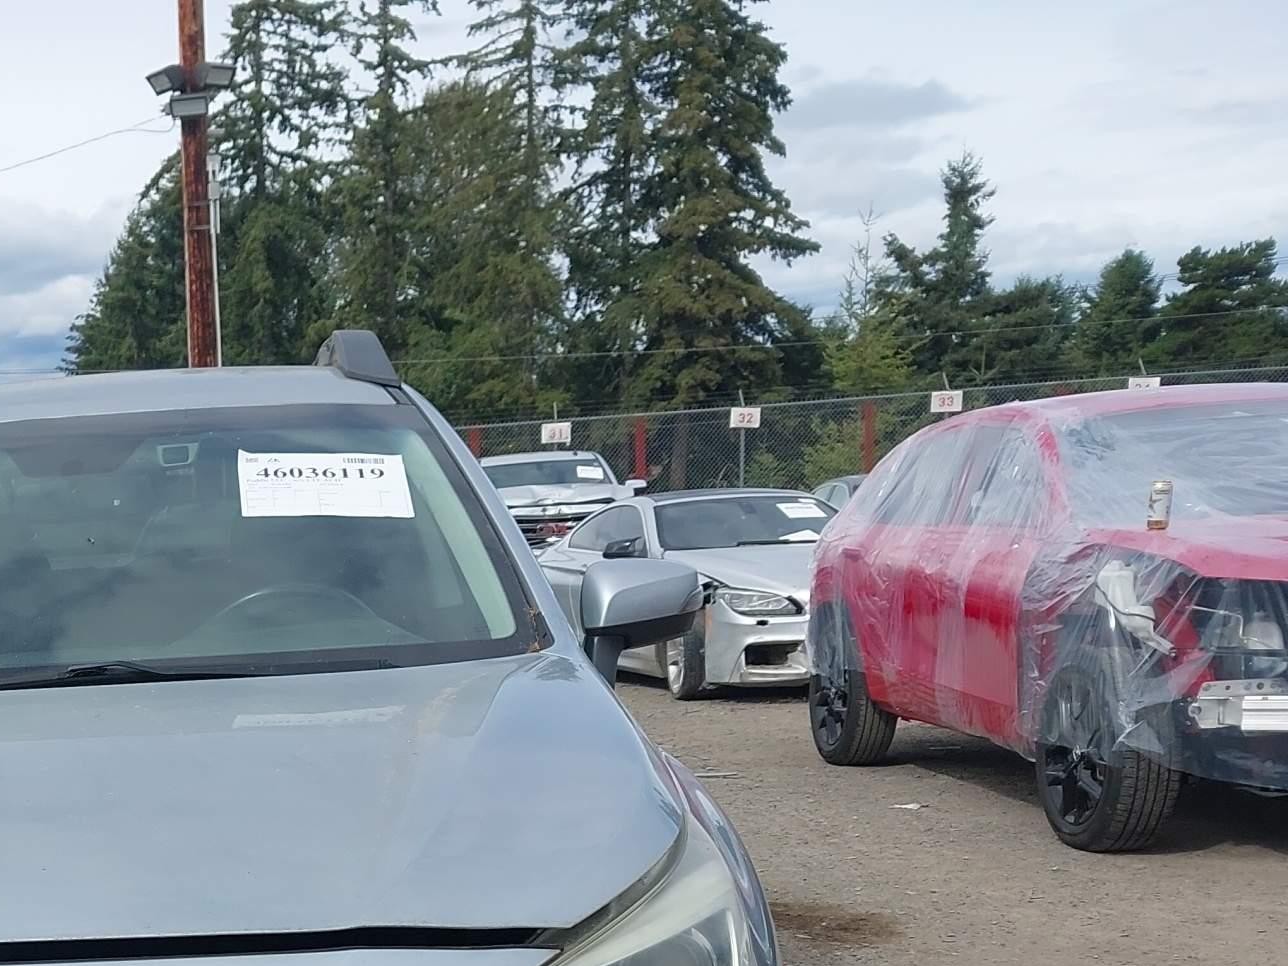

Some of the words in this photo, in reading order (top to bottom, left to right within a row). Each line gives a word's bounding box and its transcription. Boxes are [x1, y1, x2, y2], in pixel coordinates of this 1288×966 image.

[938, 395, 953, 407] 33
[738, 412, 753, 424] 32
[256, 467, 385, 479] 46036119
